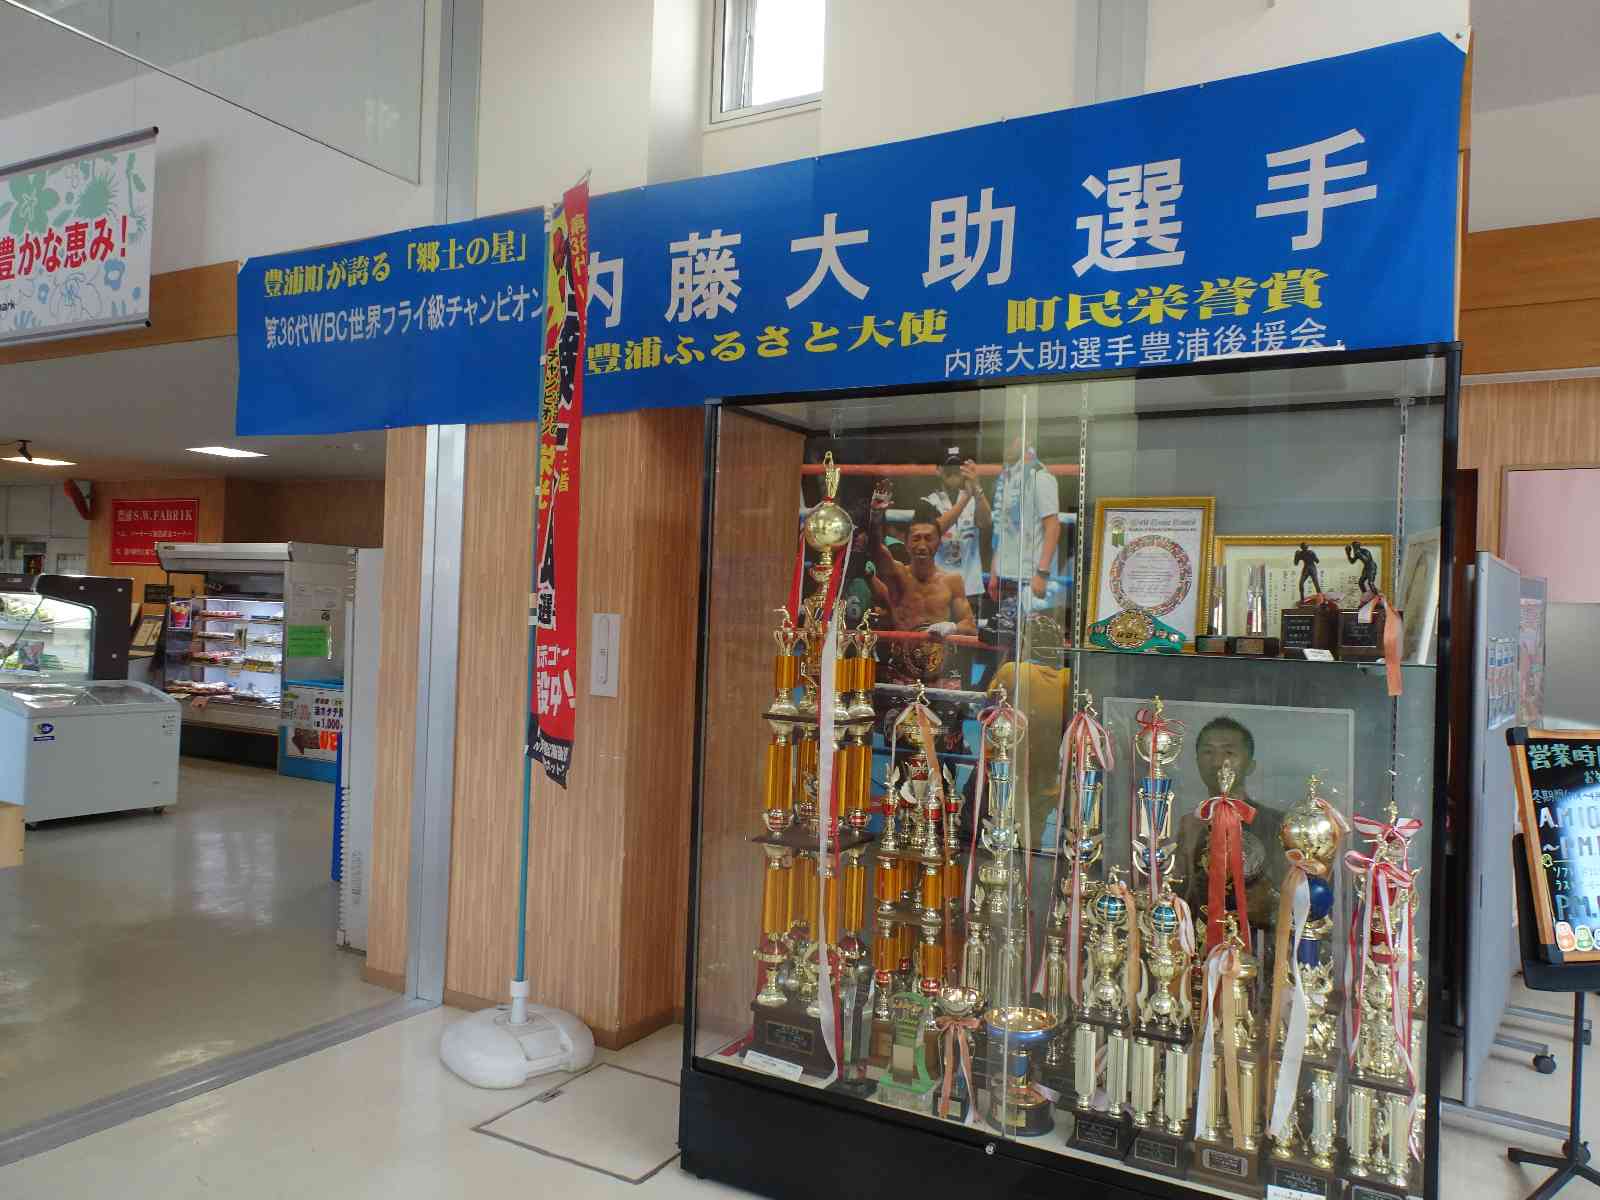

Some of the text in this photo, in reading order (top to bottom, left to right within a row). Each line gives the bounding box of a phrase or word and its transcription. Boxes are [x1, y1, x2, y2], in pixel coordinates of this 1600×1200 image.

[264, 229, 527, 297] 豊浦町が誇る 「郷土の星」
[584, 307, 949, 378] 豊浦ふるさと大使
[1006, 267, 1329, 335] 町民栄誉賞
[943, 316, 1330, 379] 内藤大助選手豊浦後援会
